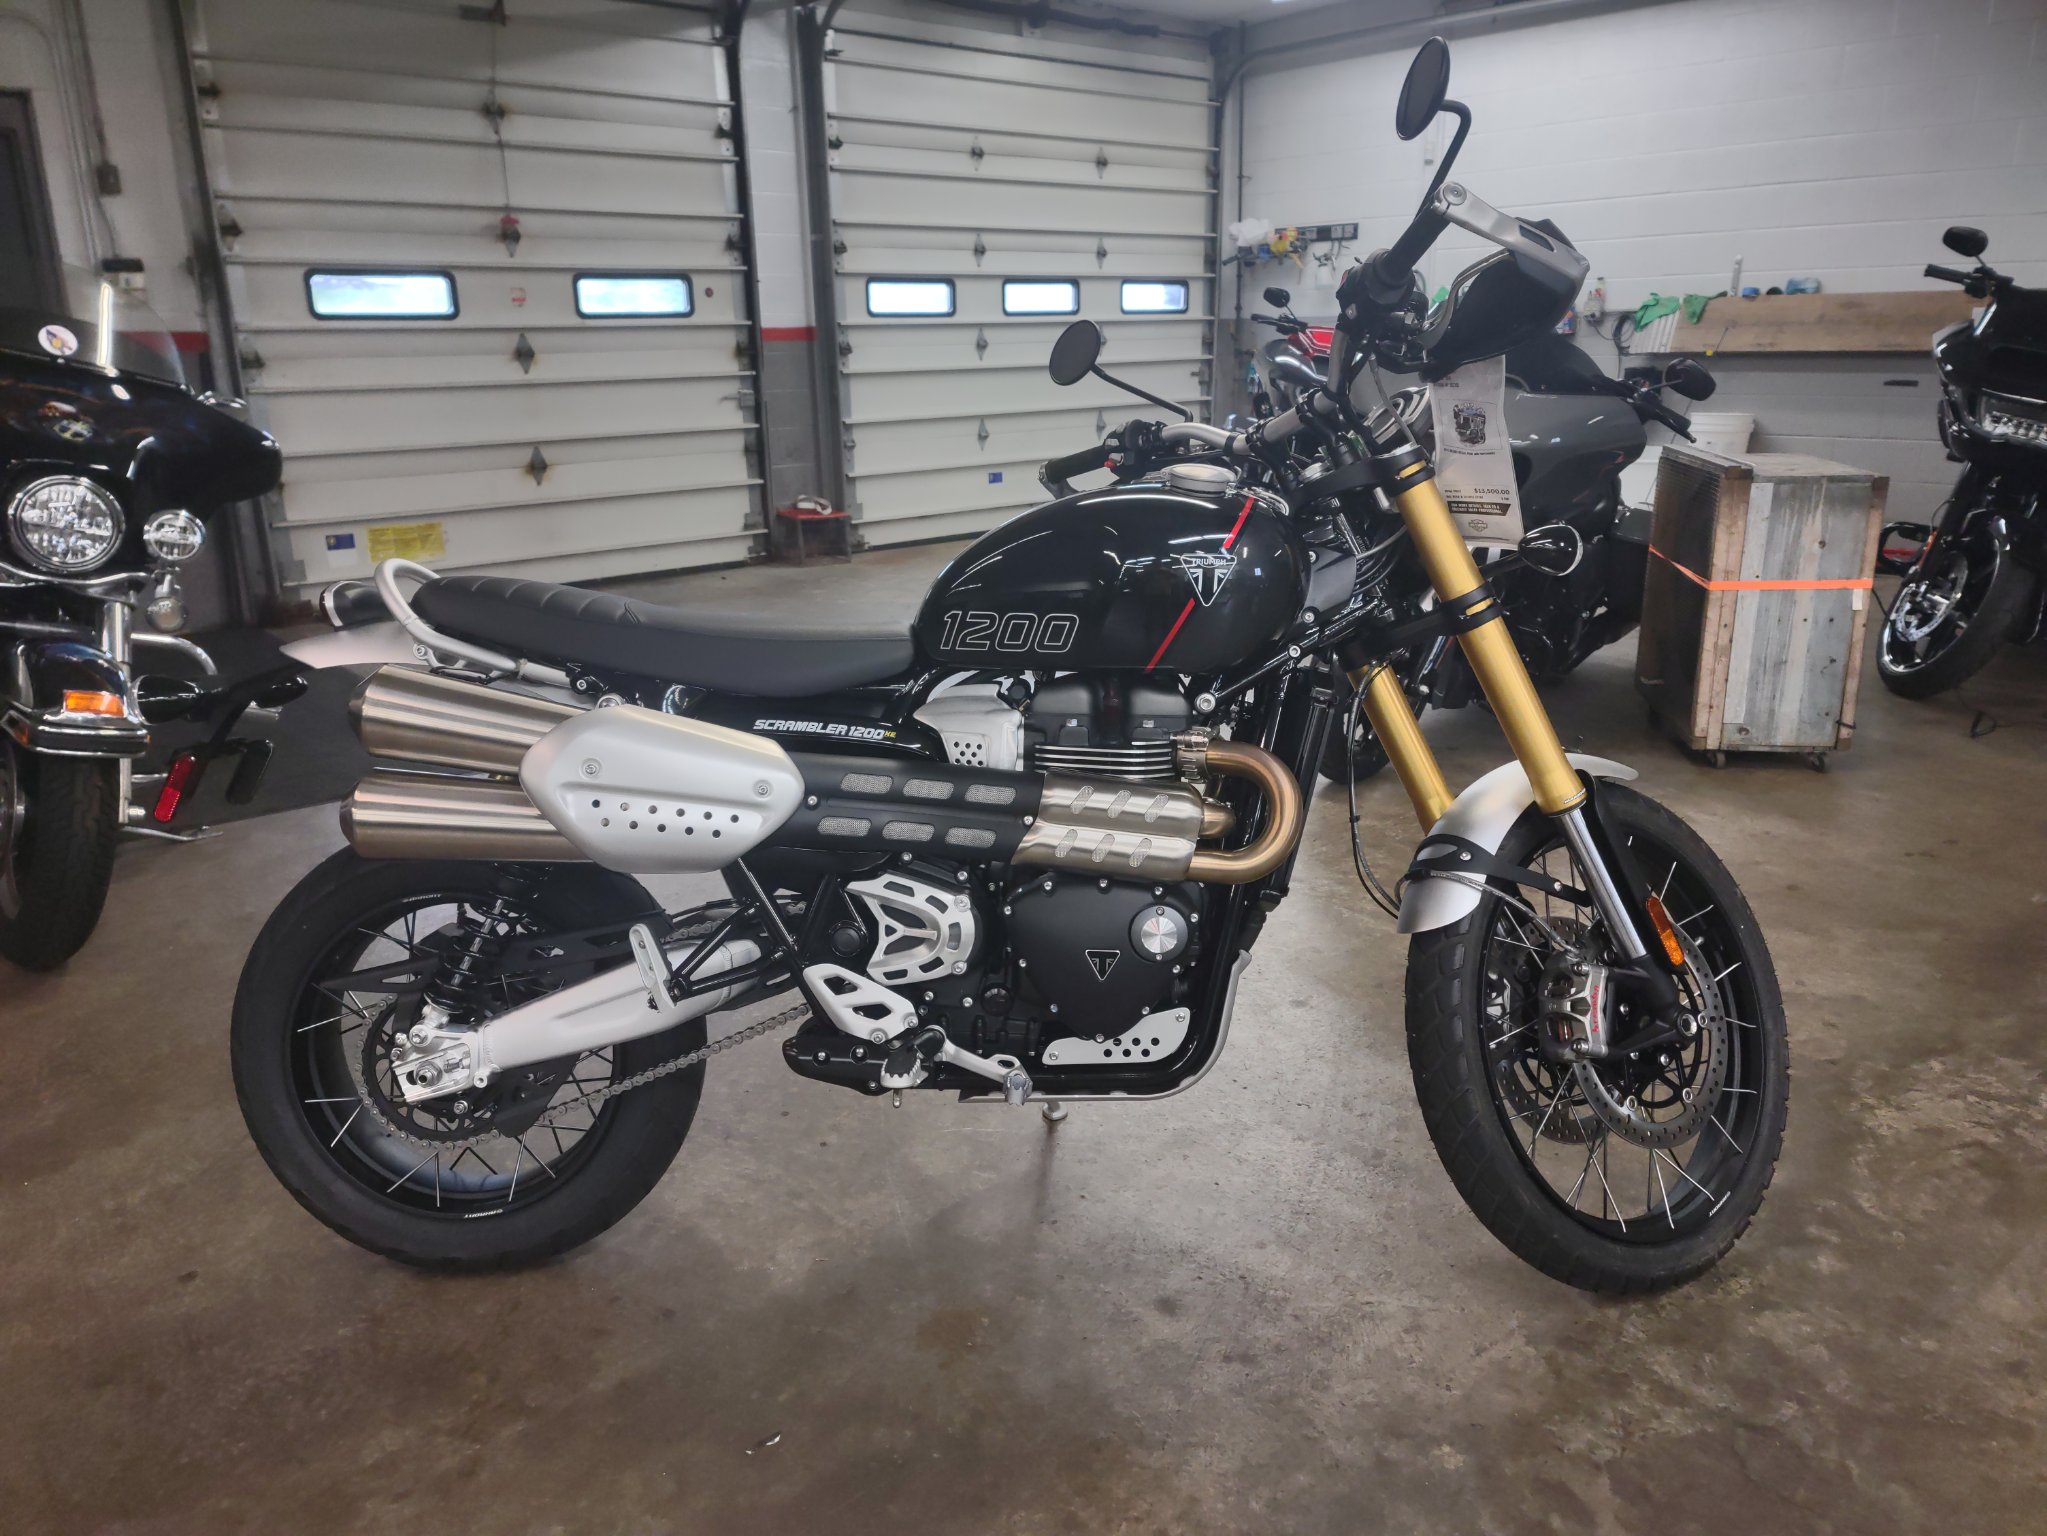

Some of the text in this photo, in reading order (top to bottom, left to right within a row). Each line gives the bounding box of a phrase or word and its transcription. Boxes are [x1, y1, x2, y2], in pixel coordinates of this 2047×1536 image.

[1192, 558, 1227, 566] TRIUMPH
[940, 610, 1079, 653] 1200
[752, 719, 847, 736] SCRAMBLER
